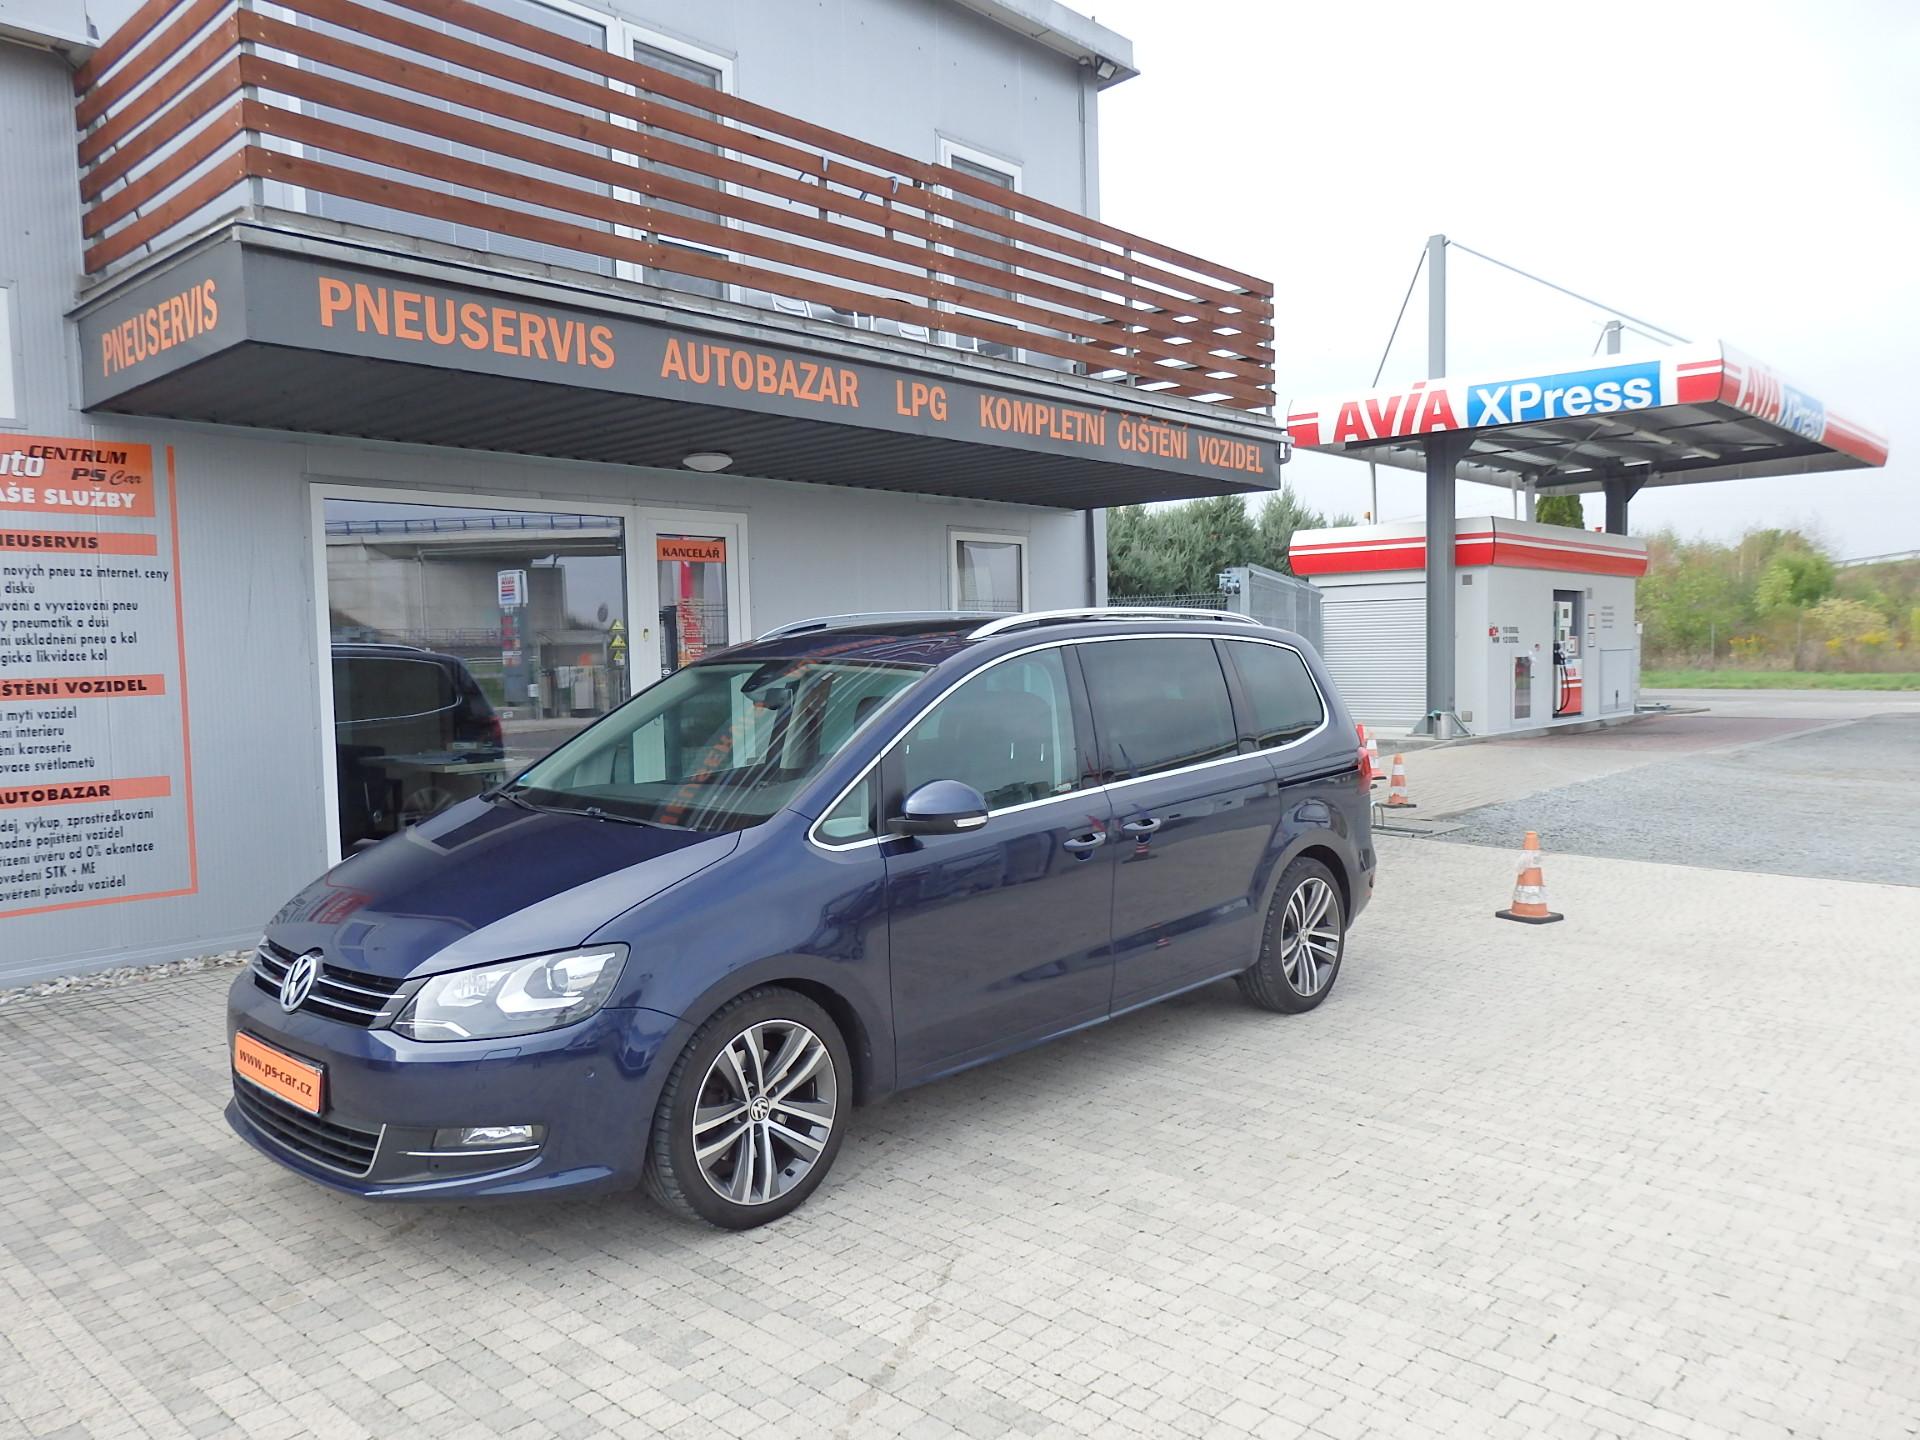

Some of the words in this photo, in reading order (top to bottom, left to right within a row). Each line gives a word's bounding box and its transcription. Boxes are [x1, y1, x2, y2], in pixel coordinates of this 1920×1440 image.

[102, 278, 218, 377] PNEUSERVIS
[319, 276, 615, 369] PNEUSERVIS
[660, 338, 859, 408] AUTOBAZAR
[897, 380, 947, 422] LPG
[980, 394, 1106, 446] KOMPLETNÍ
[1118, 412, 1188, 460] ČIŠTĚNÍ
[1198, 434, 1264, 473] VOZIDEL
[1474, 375, 1654, 427] XPress
[28, 445, 127, 464] CENTRUM
[71, 467, 107, 482] PS
[44, 486, 136, 509] SLUŽBY
[662, 546, 720, 558] KANCELÁŘ
[48, 567, 76, 580] pneu
[79, 568, 93, 578] za
[144, 570, 169, 582] ceny
[34, 602, 41, 611] a
[112, 602, 139, 614] pneu
[12, 615, 73, 632] pneumatik
[77, 619, 84, 628] a
[80, 635, 107, 648] pneu
[110, 635, 117, 644] a
[120, 631, 137, 644] kol
[36, 649, 88, 663] likvidace
[90, 648, 108, 661] kol
[65, 679, 148, 694] VOZIDEL
[37, 706, 77, 720] vozidel
[19, 740, 72, 755] karoserie
[86, 826, 124, 841] vozidel
[69, 846, 82, 859] od
[105, 843, 154, 856] akontace
[45, 864, 68, 879] STK
[81, 862, 96, 875] ME
[88, 874, 127, 891] vozidel
[239, 1049, 313, 1097] www.ps-car.cz
